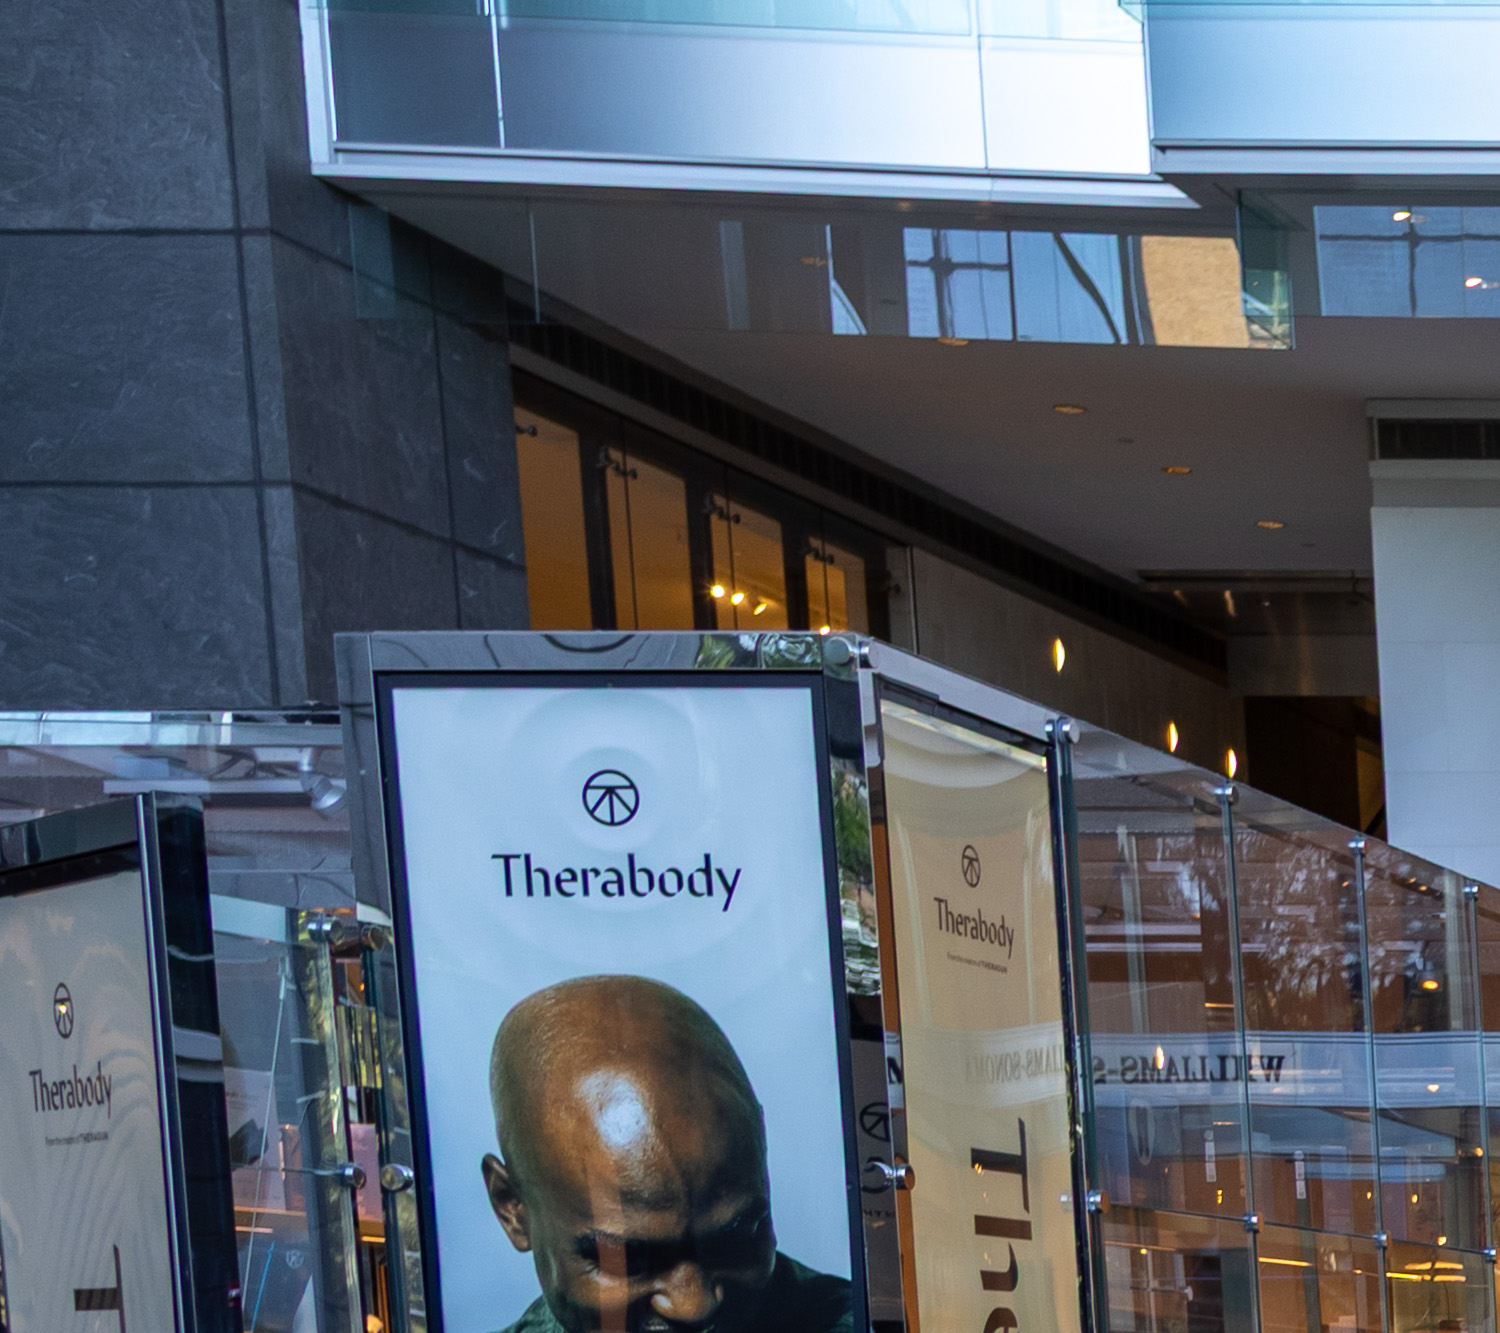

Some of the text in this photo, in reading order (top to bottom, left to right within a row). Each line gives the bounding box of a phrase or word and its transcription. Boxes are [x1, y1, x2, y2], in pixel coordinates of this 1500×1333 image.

[491, 854, 742, 912] Therabody
[933, 896, 1015, 959] Therabody
[28, 1062, 113, 1120] Therabody
